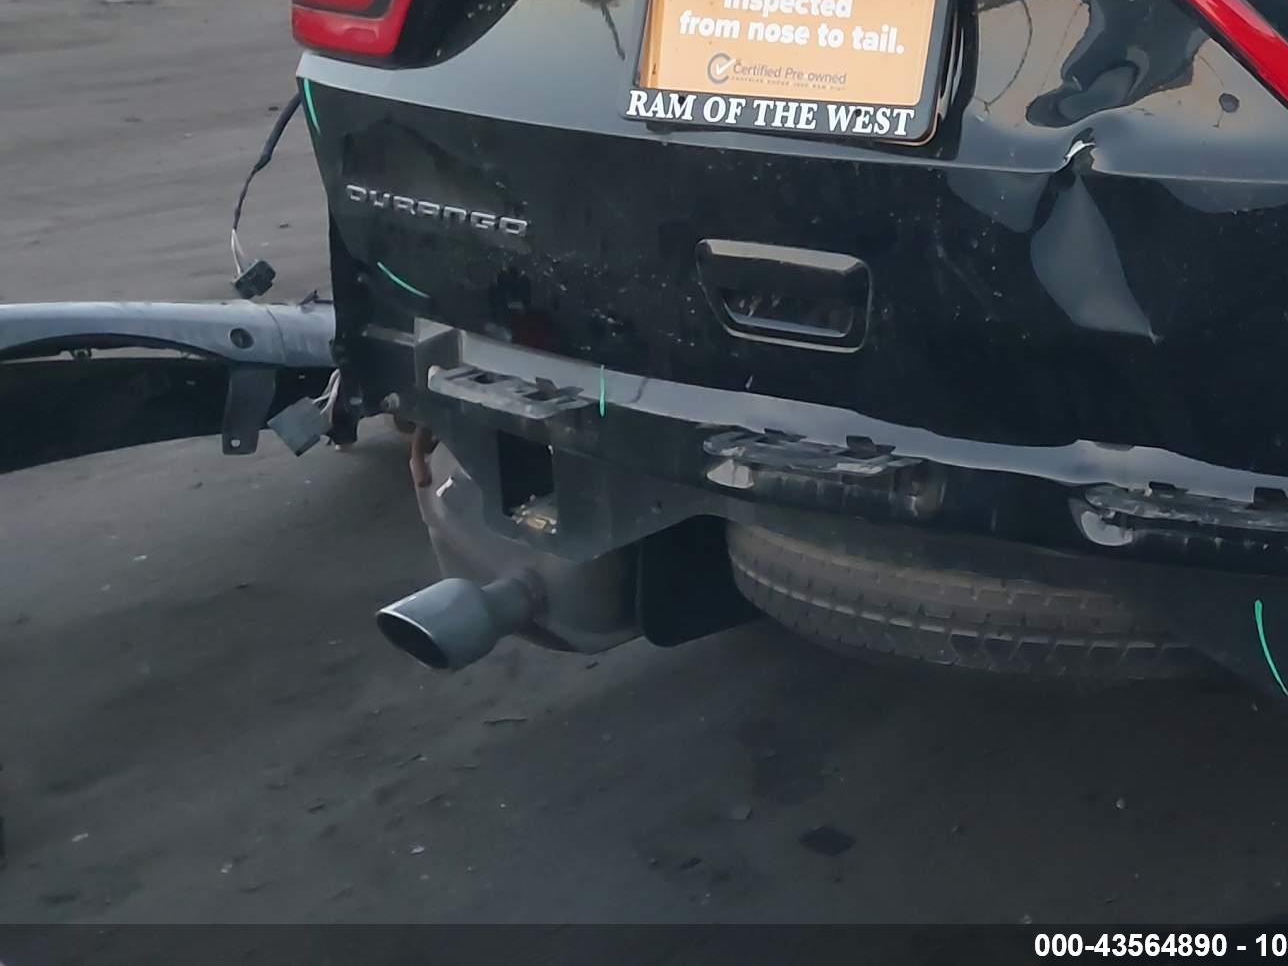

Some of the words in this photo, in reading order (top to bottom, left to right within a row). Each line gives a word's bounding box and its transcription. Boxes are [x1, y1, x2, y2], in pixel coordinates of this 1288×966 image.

[679, 10, 741, 39] from
[747, 21, 810, 45] nose
[817, 22, 844, 48] to
[852, 23, 905, 55] tail.
[733, 62, 782, 78] Certified
[626, 90, 697, 121] RAM
[702, 95, 746, 125] OF
[747, 99, 818, 131] THE
[827, 104, 915, 136] WEST
[346, 184, 528, 236] DURANGO
